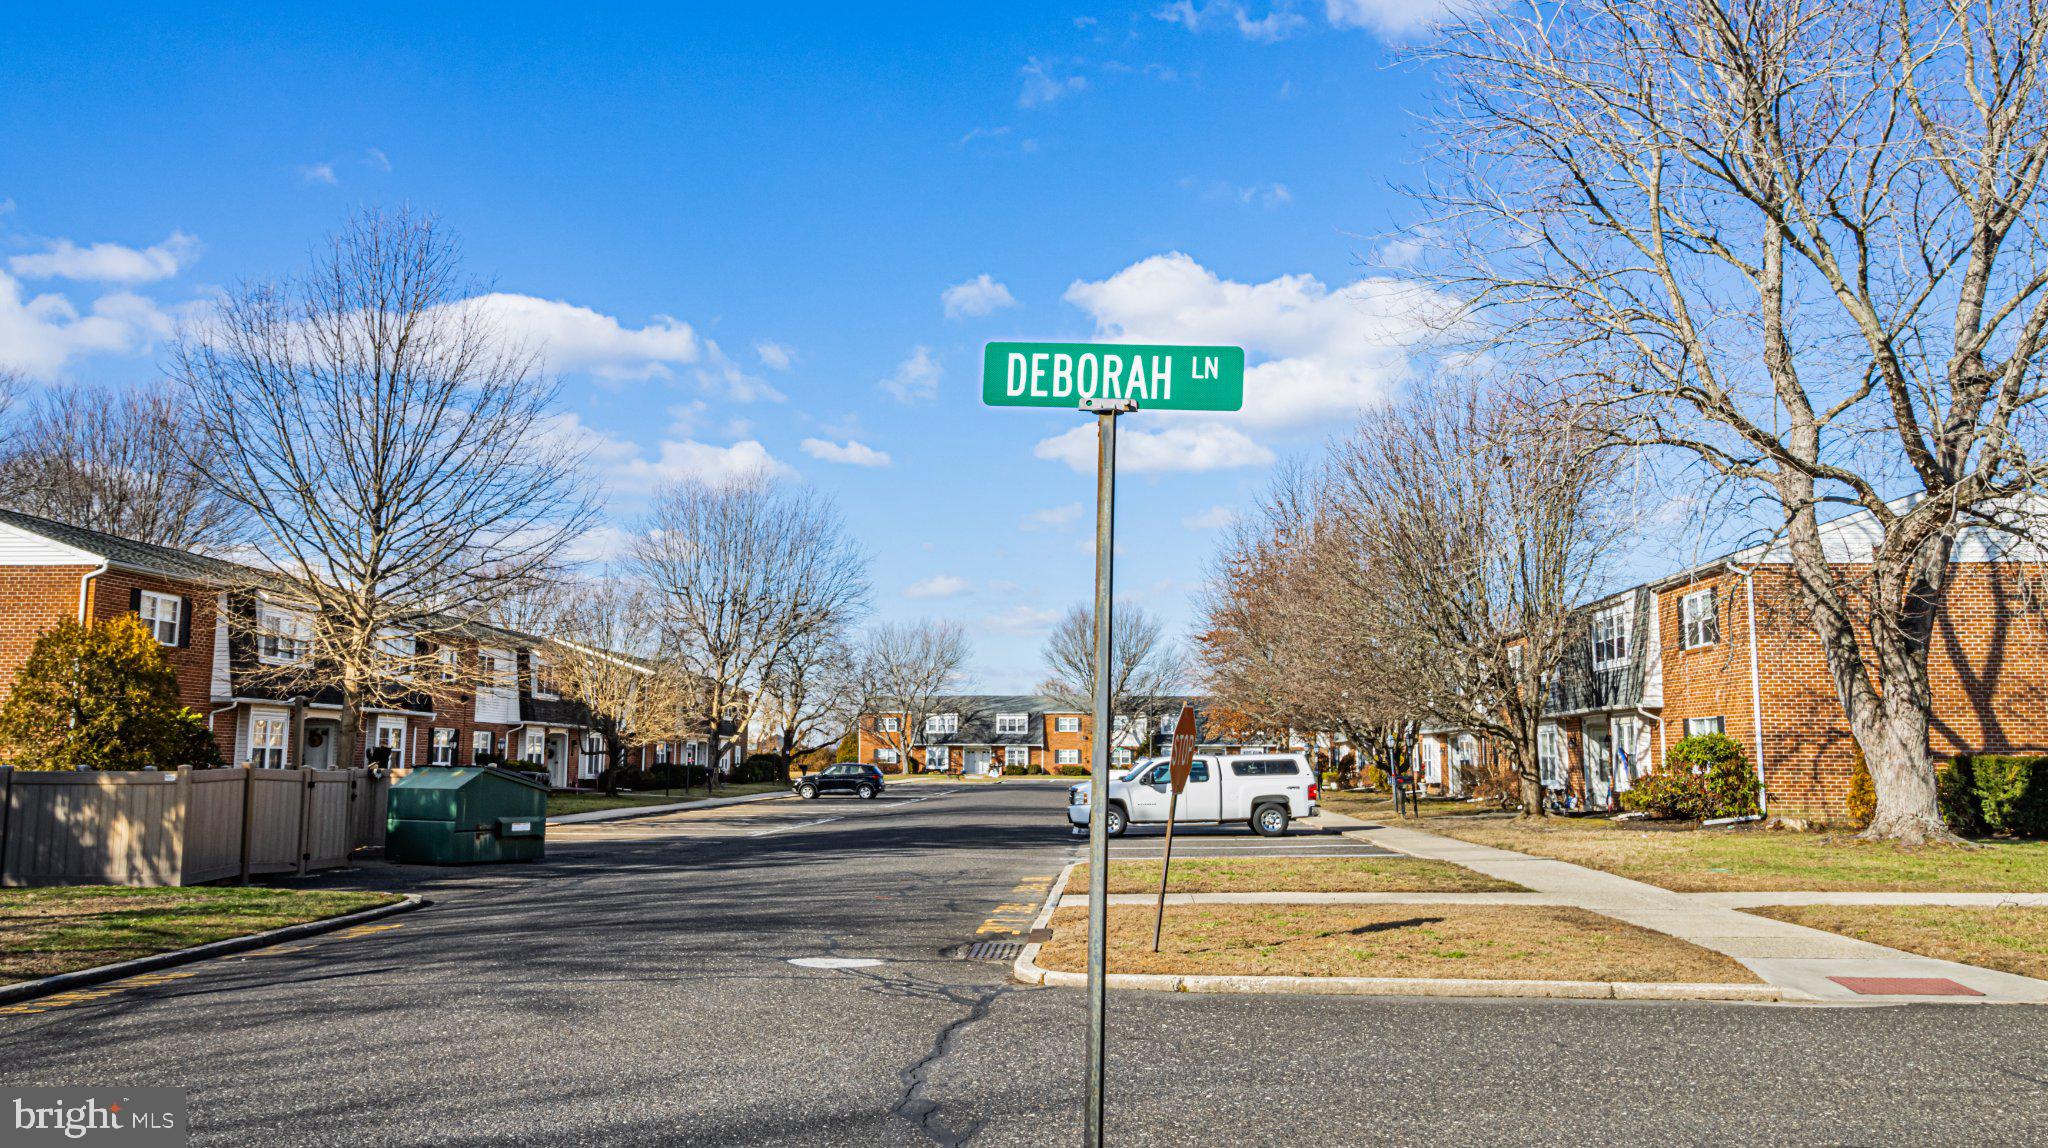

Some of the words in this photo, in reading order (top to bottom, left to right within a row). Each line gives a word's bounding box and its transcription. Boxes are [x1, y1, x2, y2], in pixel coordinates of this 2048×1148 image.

[1006, 352, 1172, 400] DEBORAH
[1191, 356, 1219, 379] LN
[1172, 734, 1195, 766] STOP
